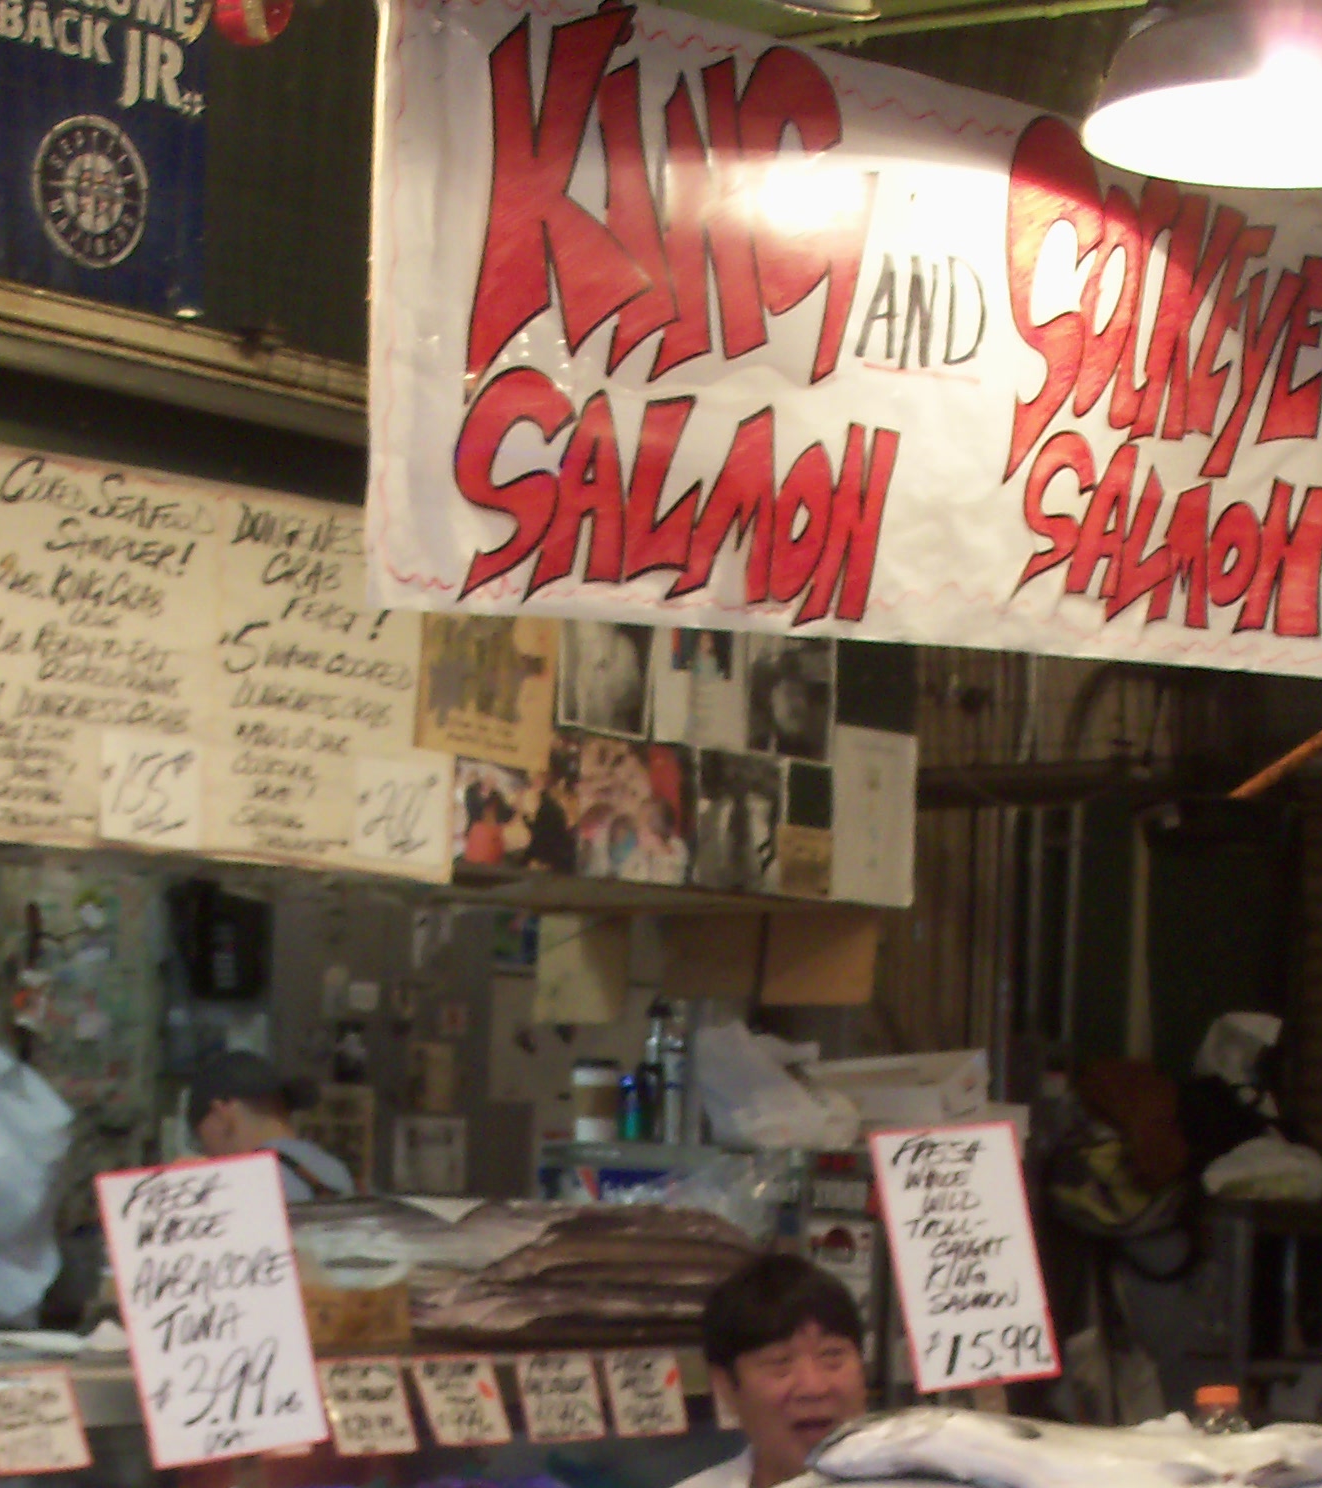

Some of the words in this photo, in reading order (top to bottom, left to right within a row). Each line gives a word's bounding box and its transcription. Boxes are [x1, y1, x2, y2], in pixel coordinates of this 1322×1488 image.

[465, 2, 845, 404] KING
[853, 253, 987, 368] AND
[454, 365, 899, 625] SALMON
[891, 1134, 985, 1166] FRESH
[122, 1172, 230, 1216] FRESH
[136, 1212, 232, 1248] WHOLE
[133, 1248, 291, 1307] ALBACORE
[924, 1261, 986, 1291] KING
[153, 1303, 244, 1353] TUNA
